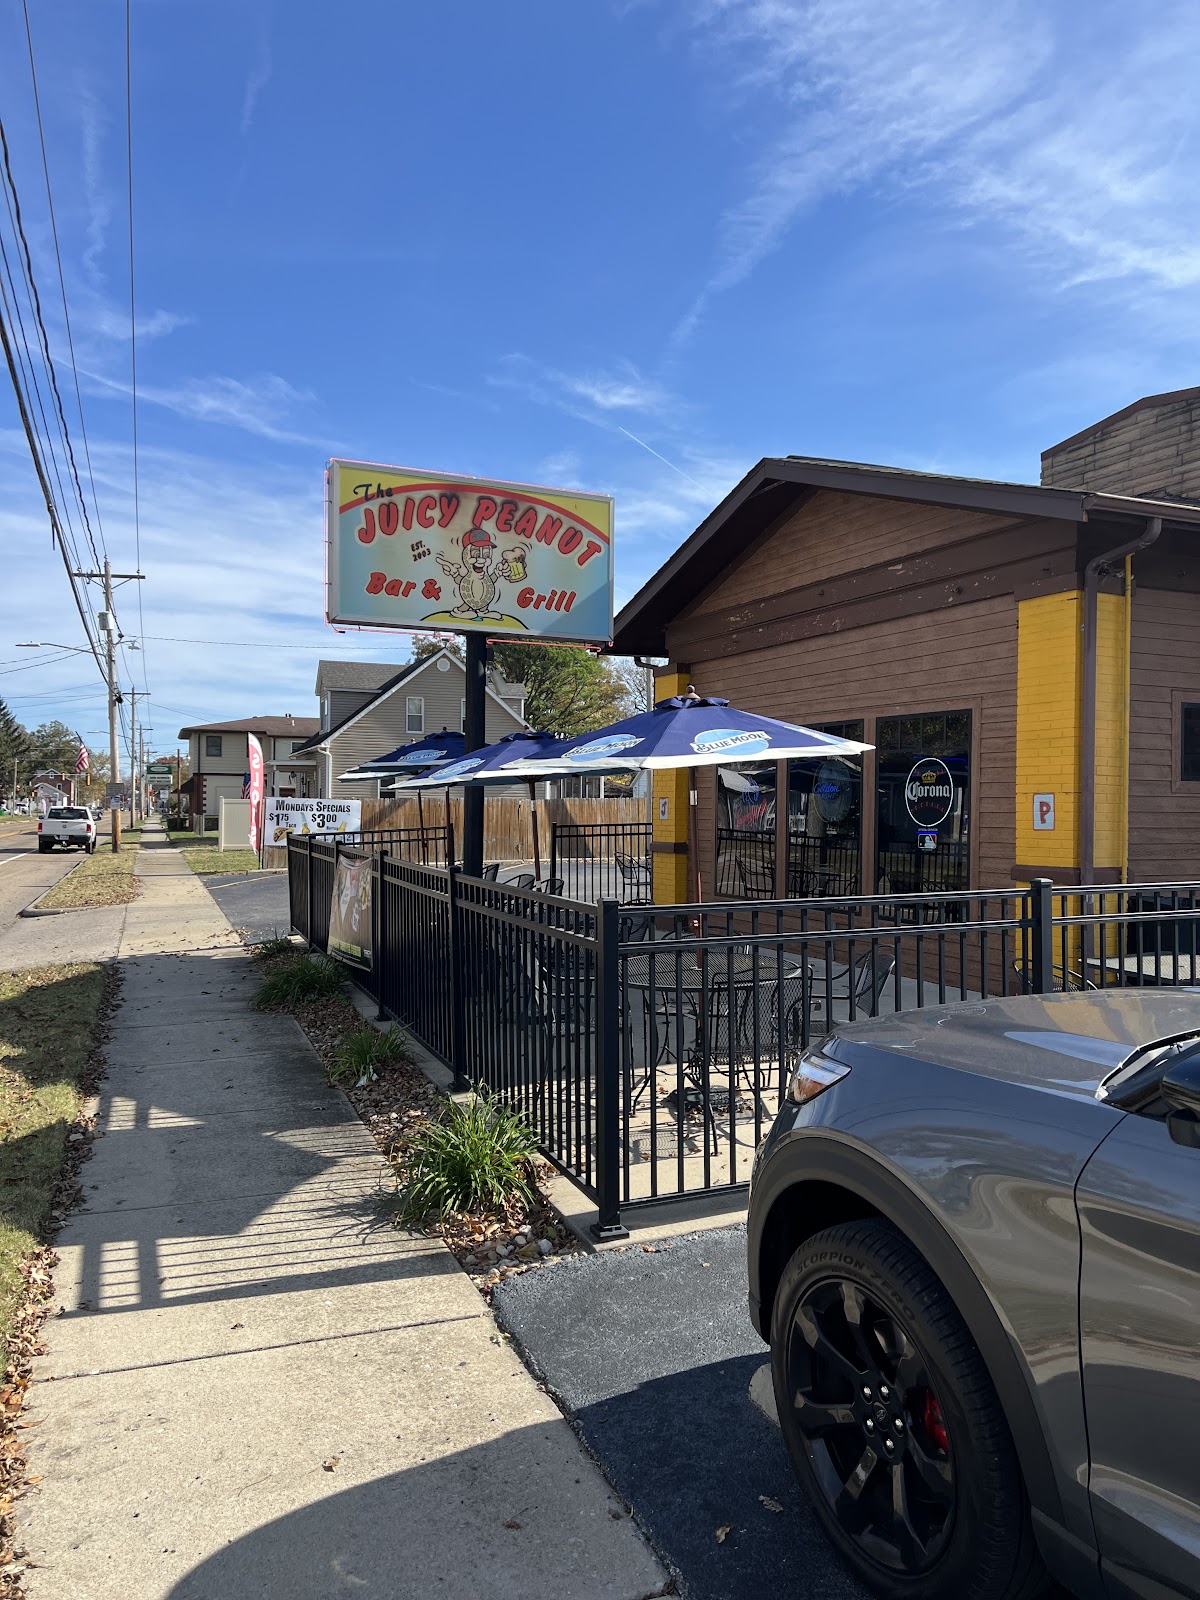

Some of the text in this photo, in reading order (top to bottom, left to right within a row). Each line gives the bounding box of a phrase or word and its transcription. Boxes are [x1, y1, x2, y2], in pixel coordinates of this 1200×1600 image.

[353, 483, 393, 502] The
[358, 495, 602, 566] JUICY PEANUT
[410, 540, 426, 552] EST.
[412, 548, 431, 562] 2003
[365, 572, 577, 613] Bar & Grill
[696, 732, 765, 753] BLUE MOON
[907, 781, 950, 802] Corona
[1039, 801, 1051, 824] P
[797, 1251, 865, 1274] SCORPION
